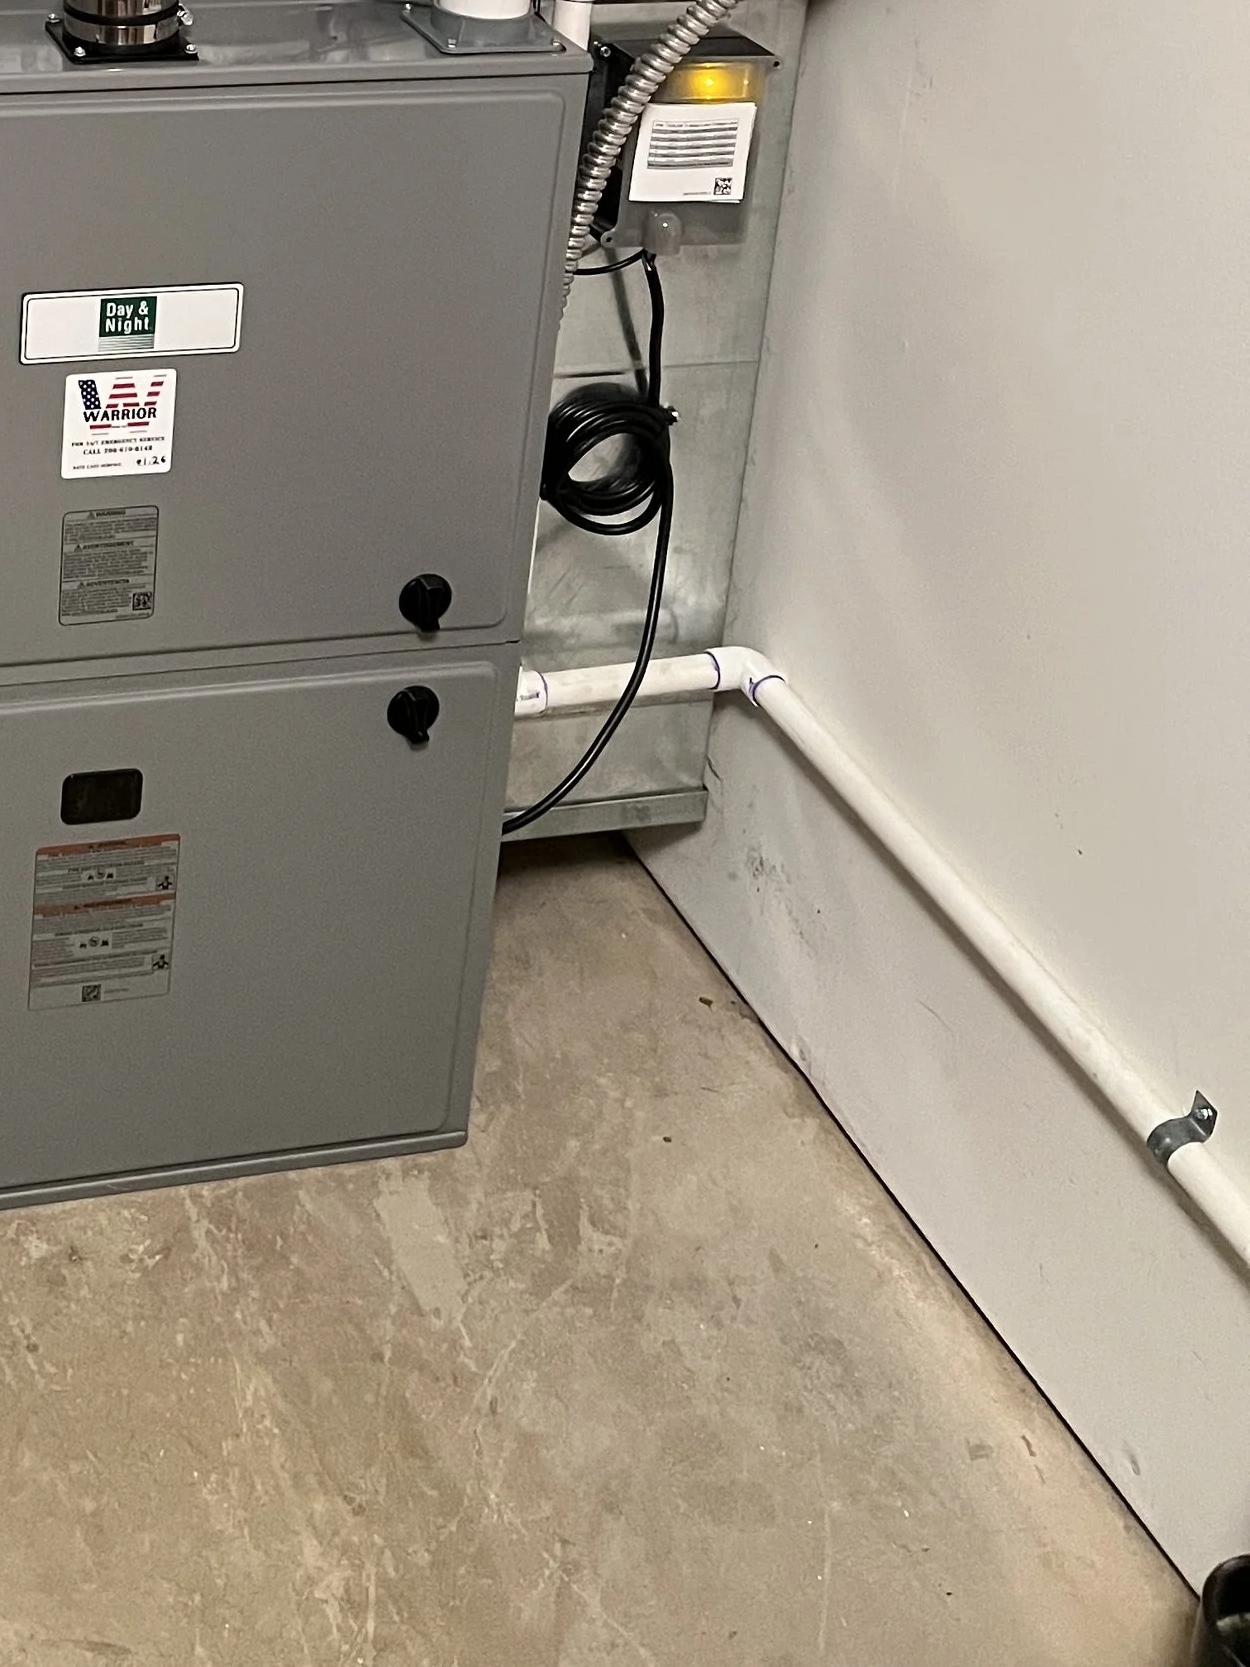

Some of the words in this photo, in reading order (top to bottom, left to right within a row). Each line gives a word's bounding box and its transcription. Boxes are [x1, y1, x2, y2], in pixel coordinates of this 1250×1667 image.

[106, 302, 134, 319] Day
[138, 300, 149, 315] &
[105, 316, 149, 334] Night
[83, 407, 157, 422] WARRIOR
